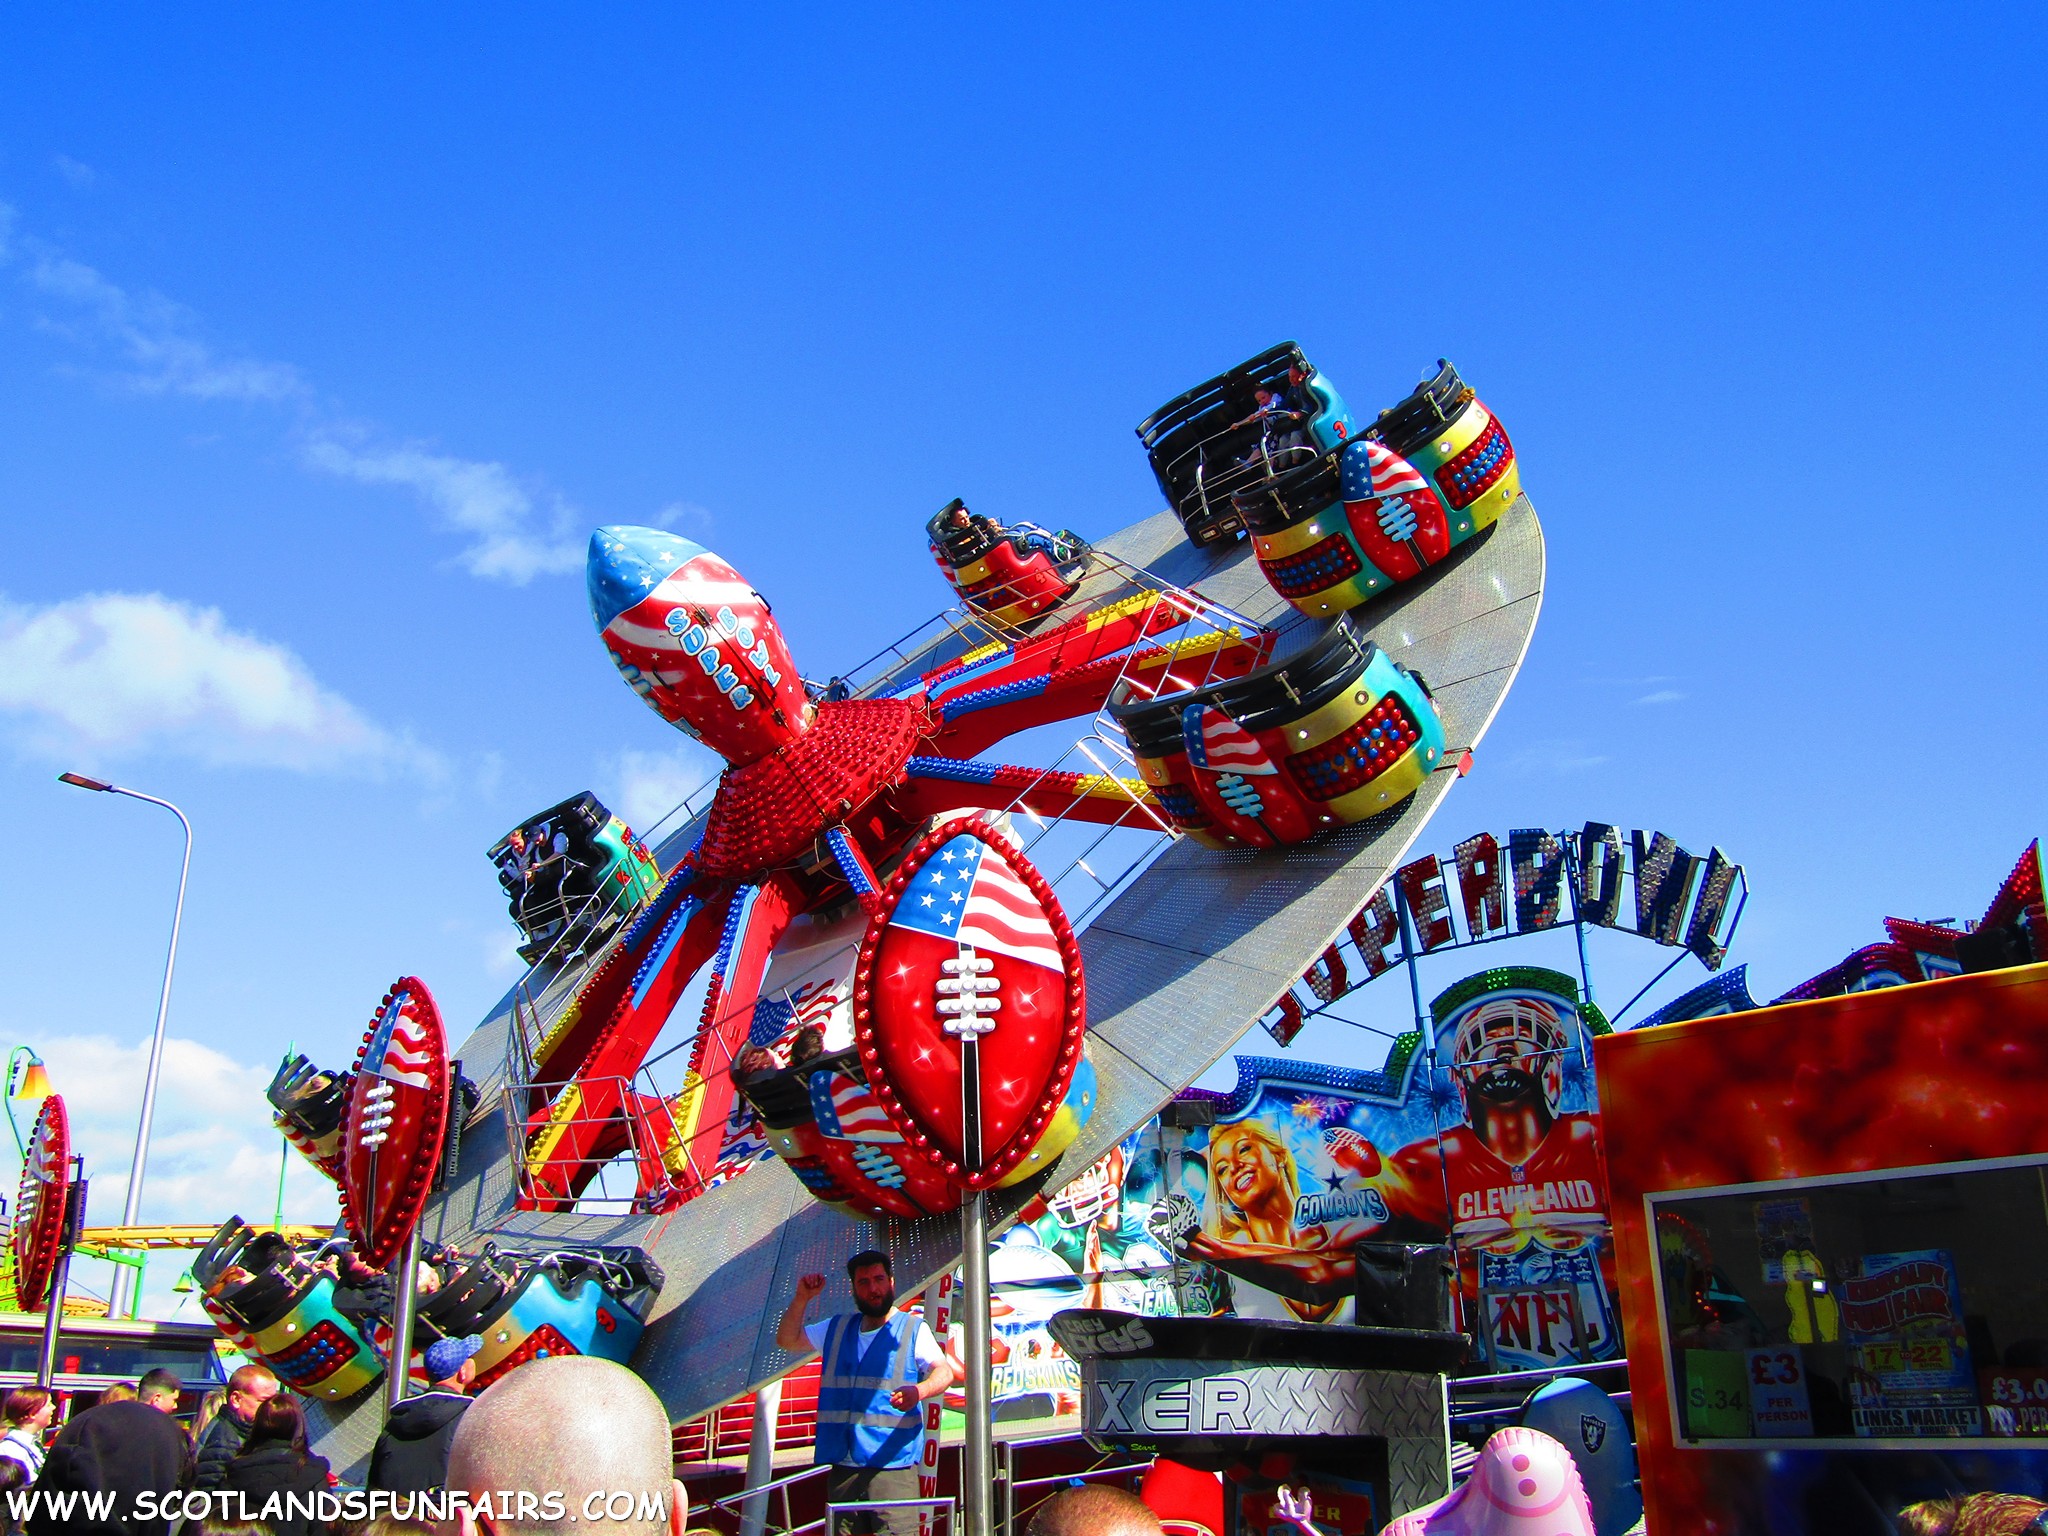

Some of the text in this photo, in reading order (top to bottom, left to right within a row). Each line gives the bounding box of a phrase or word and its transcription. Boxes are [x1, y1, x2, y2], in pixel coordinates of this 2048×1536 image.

[1333, 420, 1348, 440] 3
[664, 607, 755, 711] SUPER
[716, 605, 782, 688] BOWL
[1294, 1188, 1390, 1230] COWBOYS
[1458, 1180, 1597, 1220] CLEVELAND
[1142, 1285, 1212, 1317] EAGLES
[1840, 1286, 1953, 1333] FUN FAIR
[1495, 1292, 1600, 1358] NFL
[991, 1360, 1081, 1398] REDSKINS
[1750, 1352, 1799, 1386] £3
[1757, 1409, 1808, 1423] PERSON
[1767, 1397, 1793, 1409] PER
[1855, 1408, 1904, 1427] LINKS
[1907, 1407, 1978, 1426] MARKET
